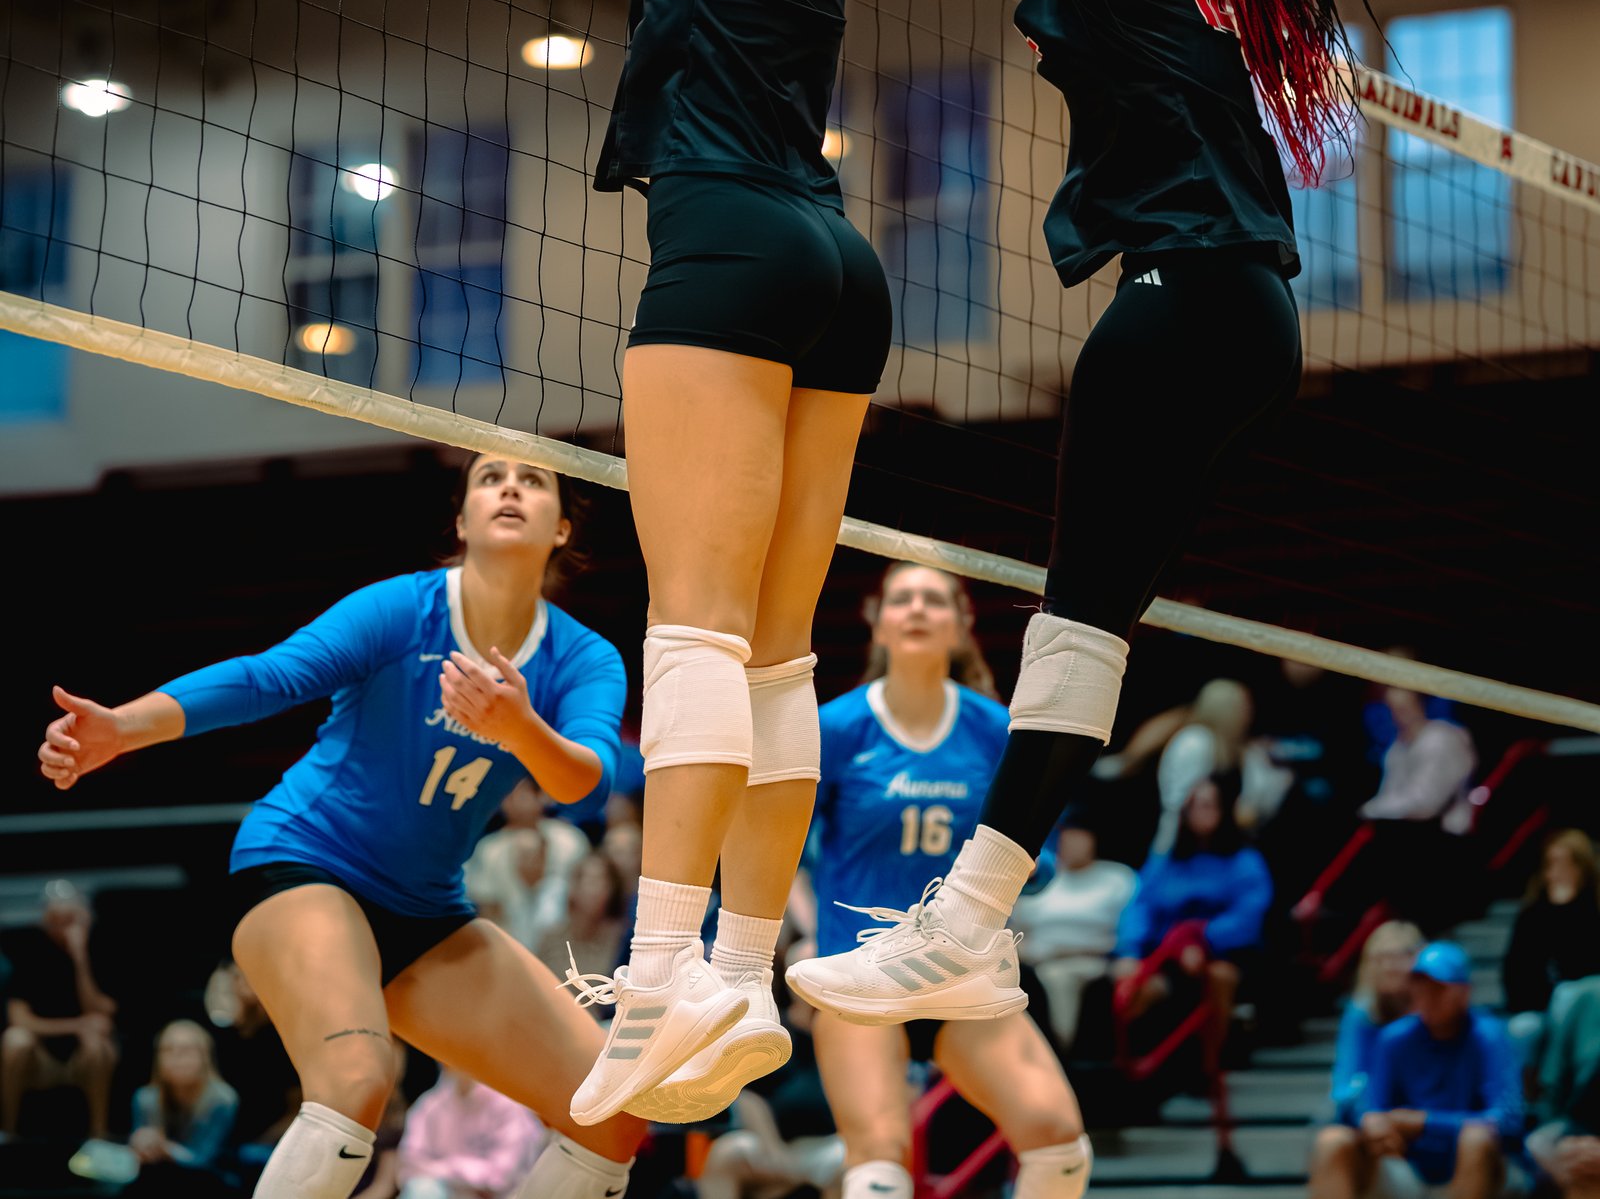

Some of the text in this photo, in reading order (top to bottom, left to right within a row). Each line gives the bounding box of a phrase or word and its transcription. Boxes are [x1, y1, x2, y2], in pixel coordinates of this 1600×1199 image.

[1359, 77, 1461, 139] ARDINALS
[418, 746, 493, 811] 14
[900, 804, 954, 856] 16
